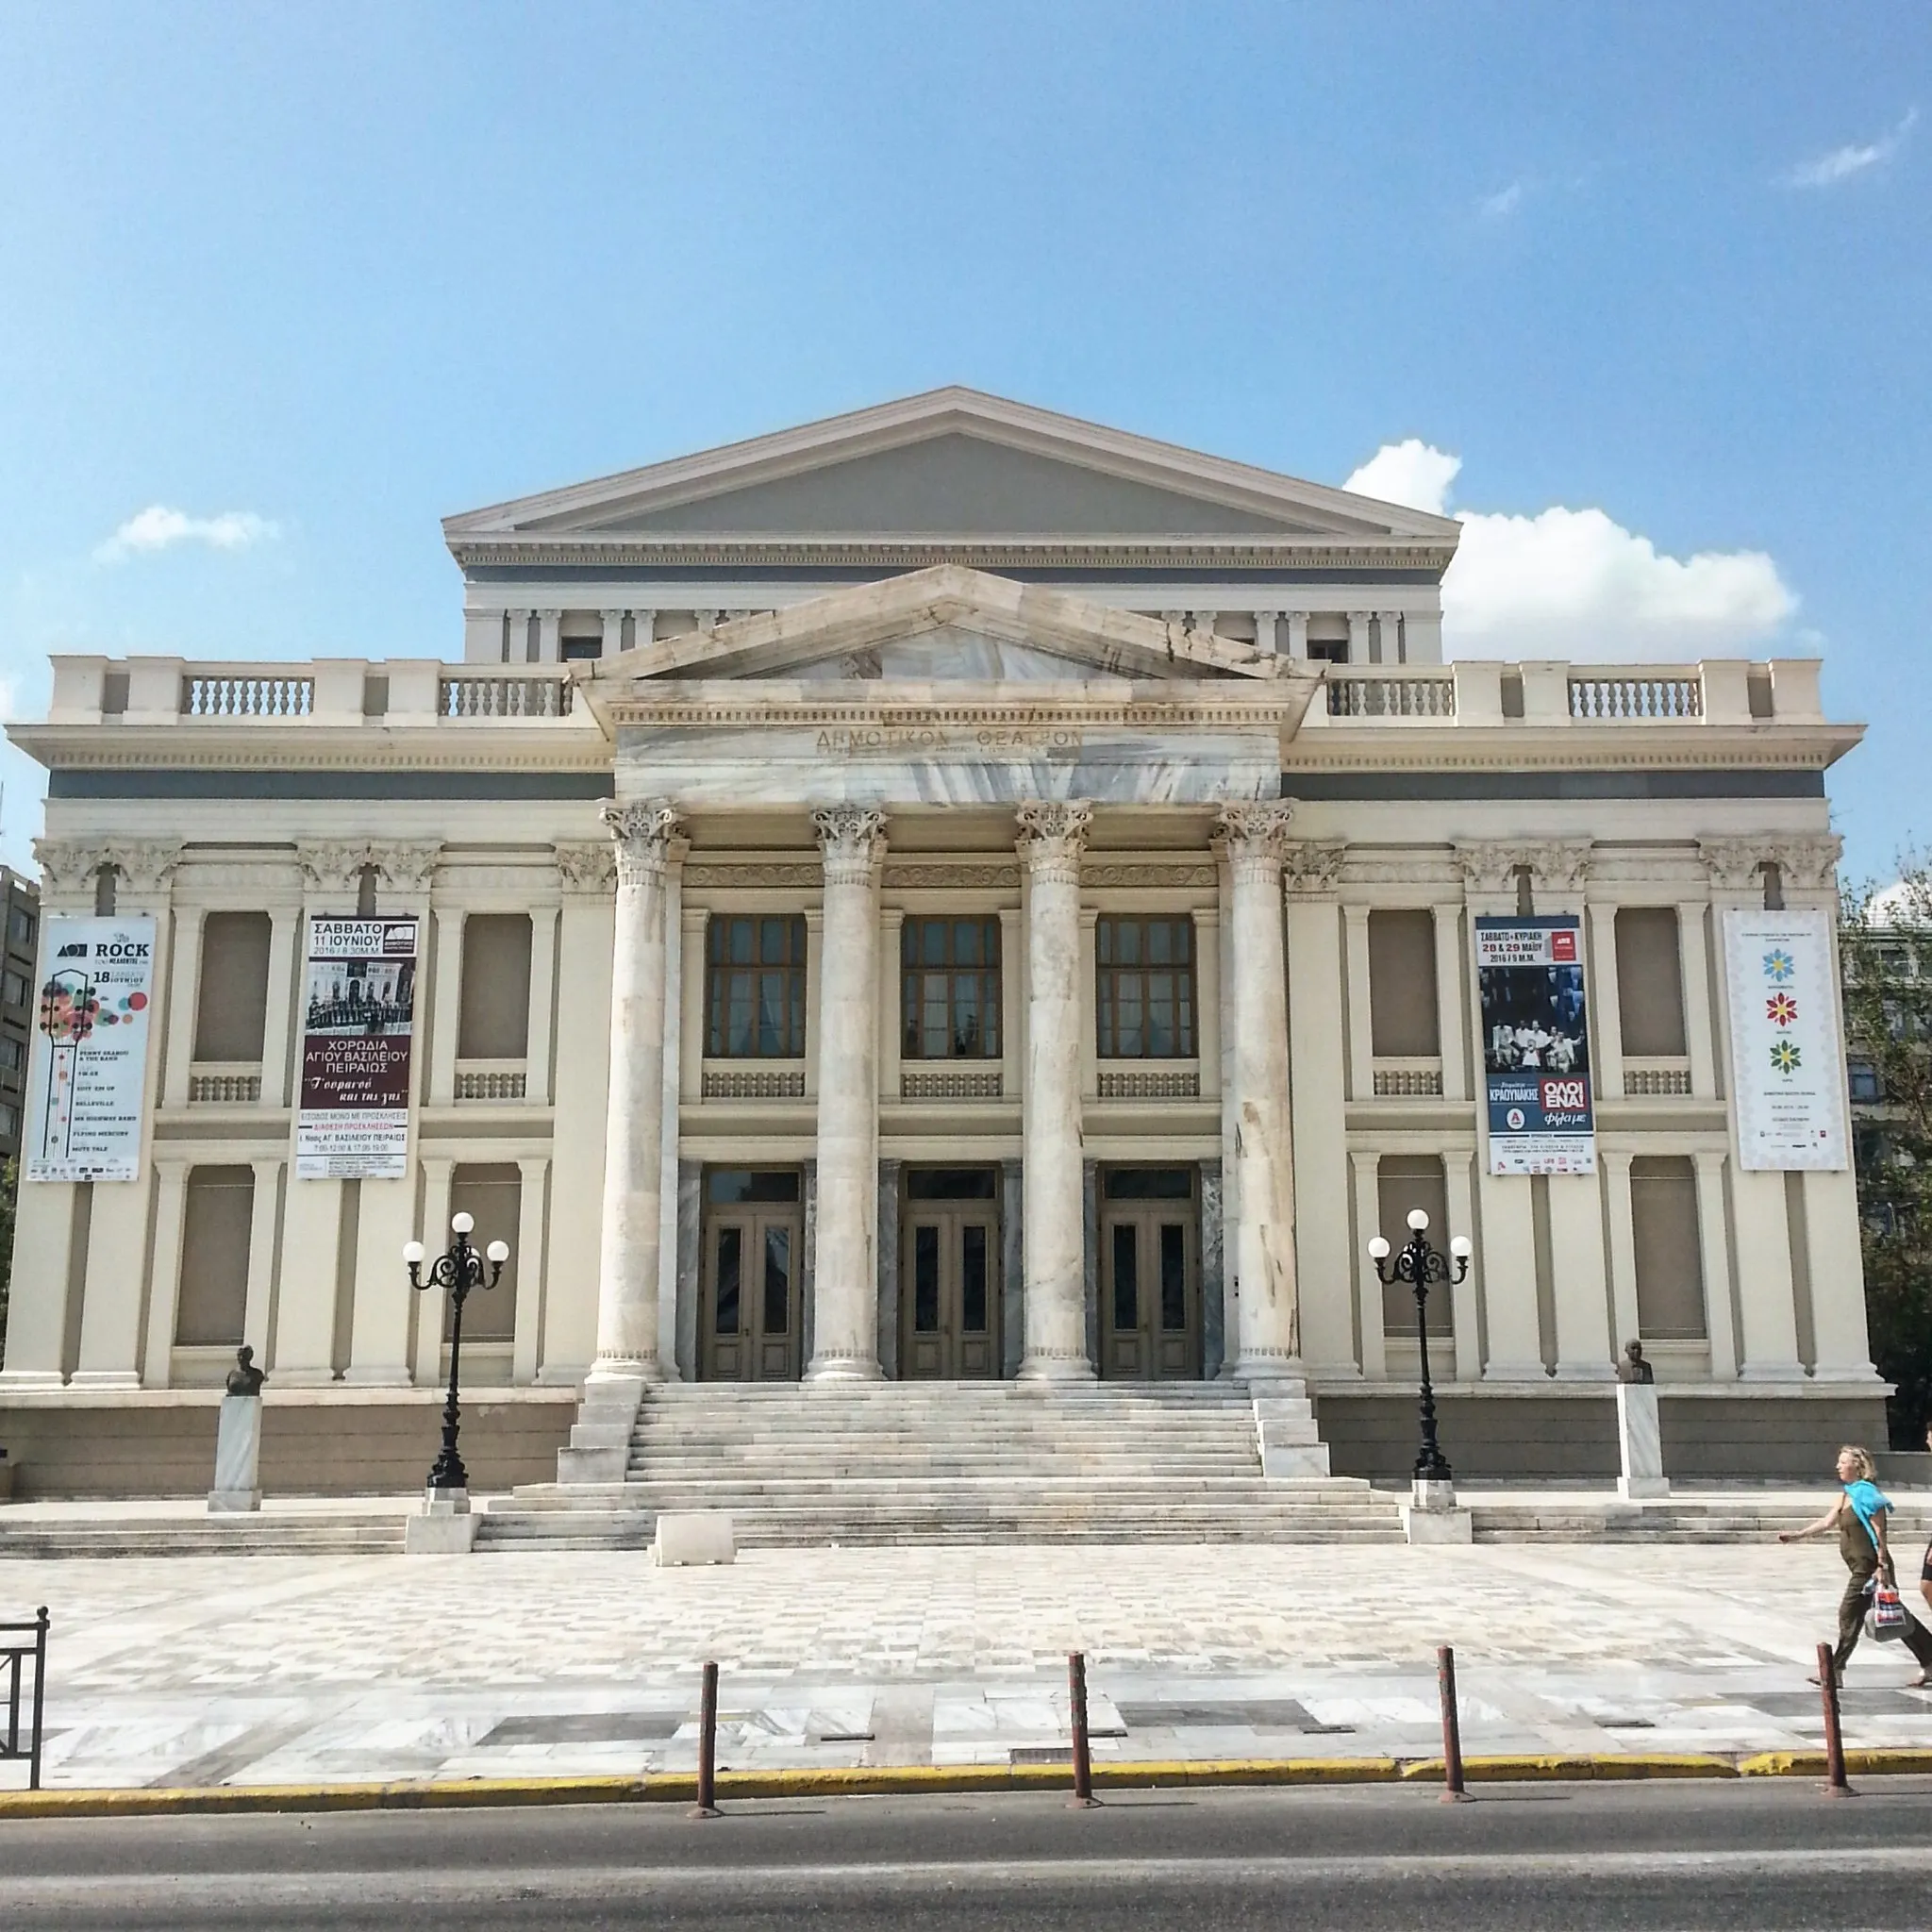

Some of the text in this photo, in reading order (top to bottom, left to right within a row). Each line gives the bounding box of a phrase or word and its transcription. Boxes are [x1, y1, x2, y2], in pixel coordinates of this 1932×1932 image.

[817, 730, 1082, 746] ΔΗΜΟΤΙΚΟΝ ΘΕΑΤΡΟΝ
[314, 924, 382, 934] ΣΑΒΒΑΤΟ
[314, 936, 381, 946] 11 ΙΟΥΝΙΟΥ
[1481, 932, 1542, 941] ΣΑΒΒΑΤΟ ΚΥΡΙΑΚΗ
[95, 943, 150, 957] ROCK
[1483, 943, 1496, 952] 28
[1498, 943, 1504, 952] &
[1506, 943, 1520, 952] 29
[1490, 954, 1506, 962] 2016
[93, 972, 109, 983] 18
[328, 1041, 388, 1050] ΧΟΡΩΔΙΑ
[306, 1051, 408, 1062] ΑΓΙΟΥ ΒΑΣΙΛΕΙΟΥ
[325, 1062, 388, 1073] ΠΕΙΡΑΙΩΣ
[1490, 1088, 1539, 1102] ΚΡΑΟΥΝΑΚΗΣ
[301, 1112, 328, 1121] ΕΙΣΟΔΟΣ
